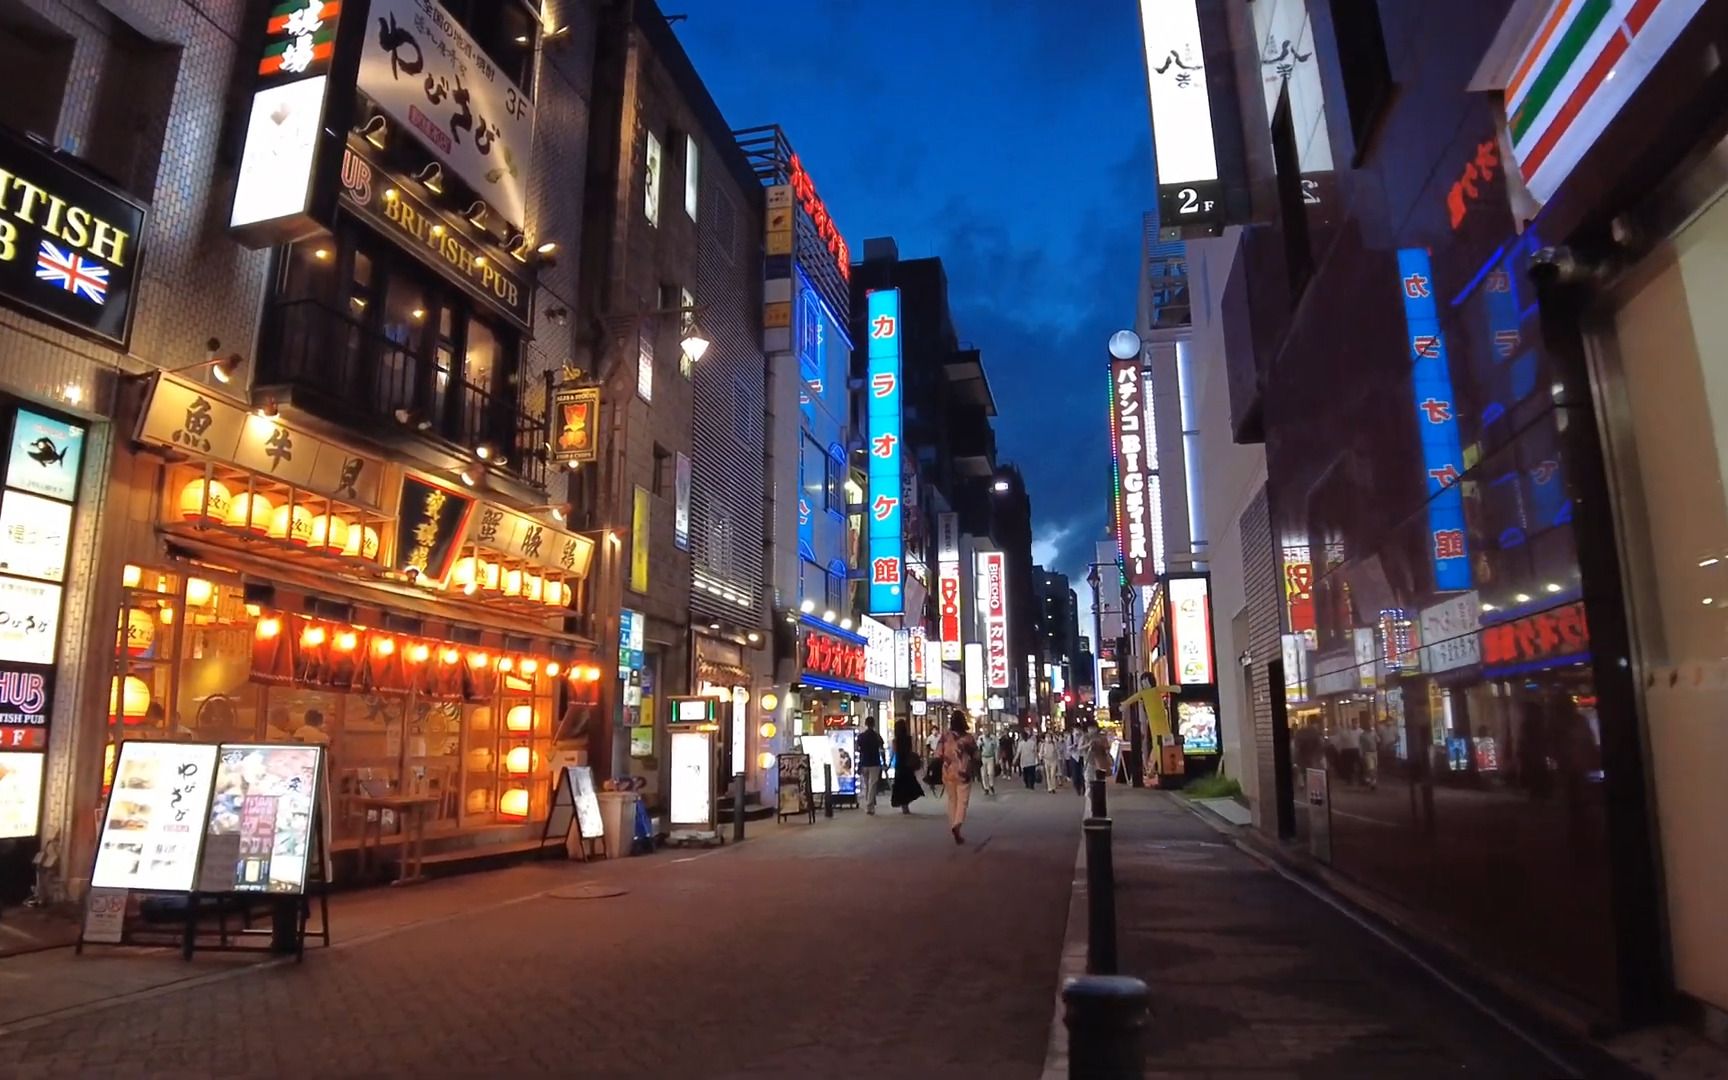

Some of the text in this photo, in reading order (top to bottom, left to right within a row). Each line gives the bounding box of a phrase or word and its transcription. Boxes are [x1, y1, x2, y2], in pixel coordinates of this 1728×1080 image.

[505, 86, 528, 121] 3F
[384, 196, 519, 309] BRITISH PUB
[870, 314, 900, 585] カラオケ館
[806, 631, 866, 682] カラオケ館
